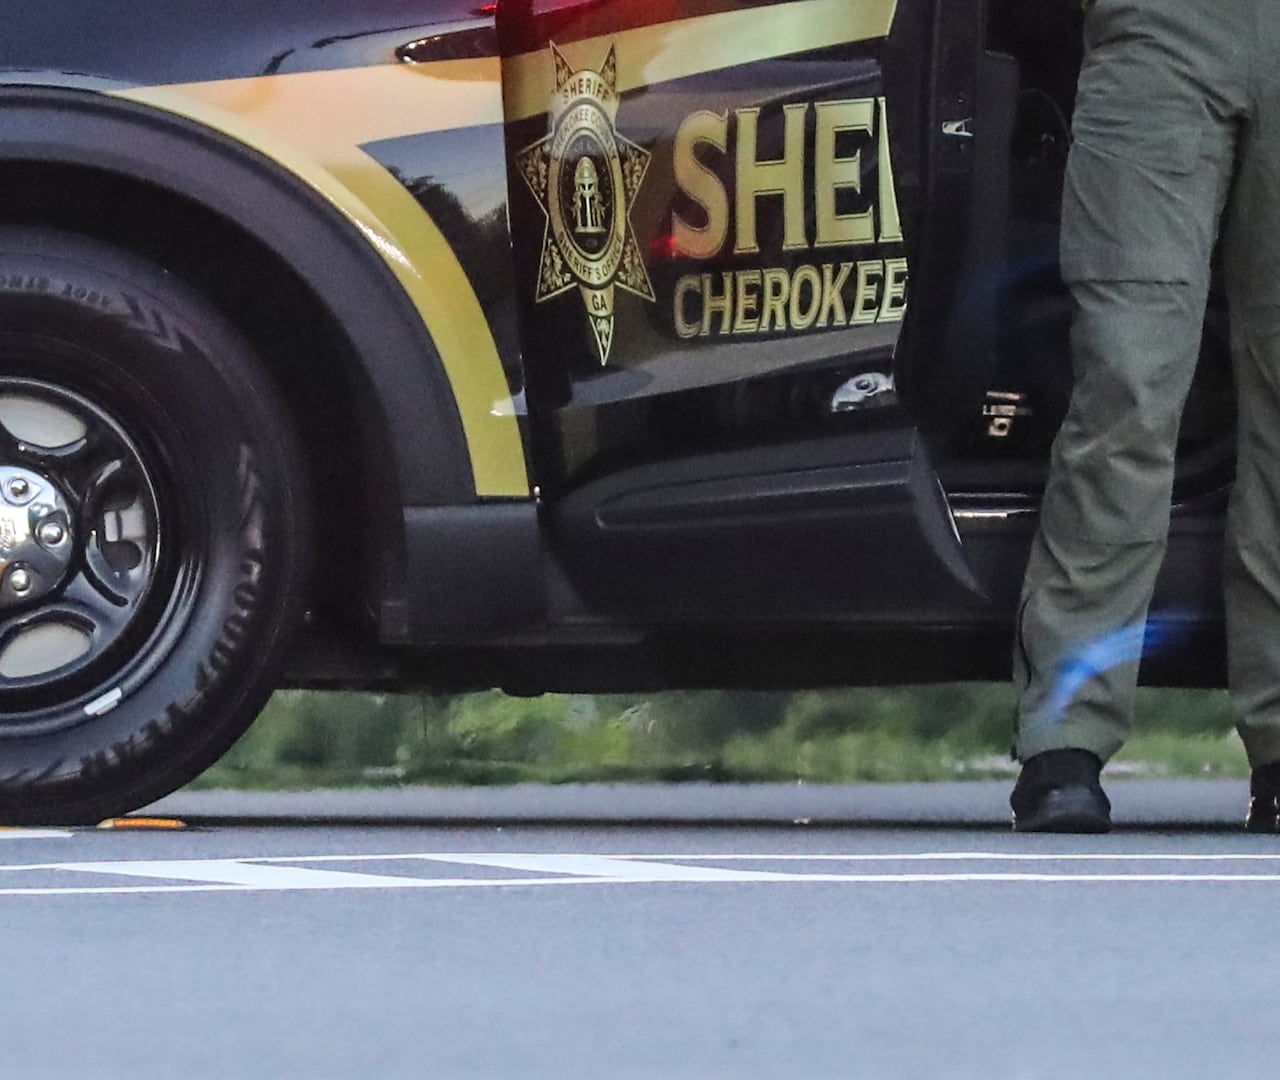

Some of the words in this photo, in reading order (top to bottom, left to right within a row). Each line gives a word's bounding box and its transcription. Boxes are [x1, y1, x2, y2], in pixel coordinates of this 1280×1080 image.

[562, 77, 610, 105] SHERIFF
[591, 293, 608, 311] GA
[673, 257, 908, 339] CHEROKEE
